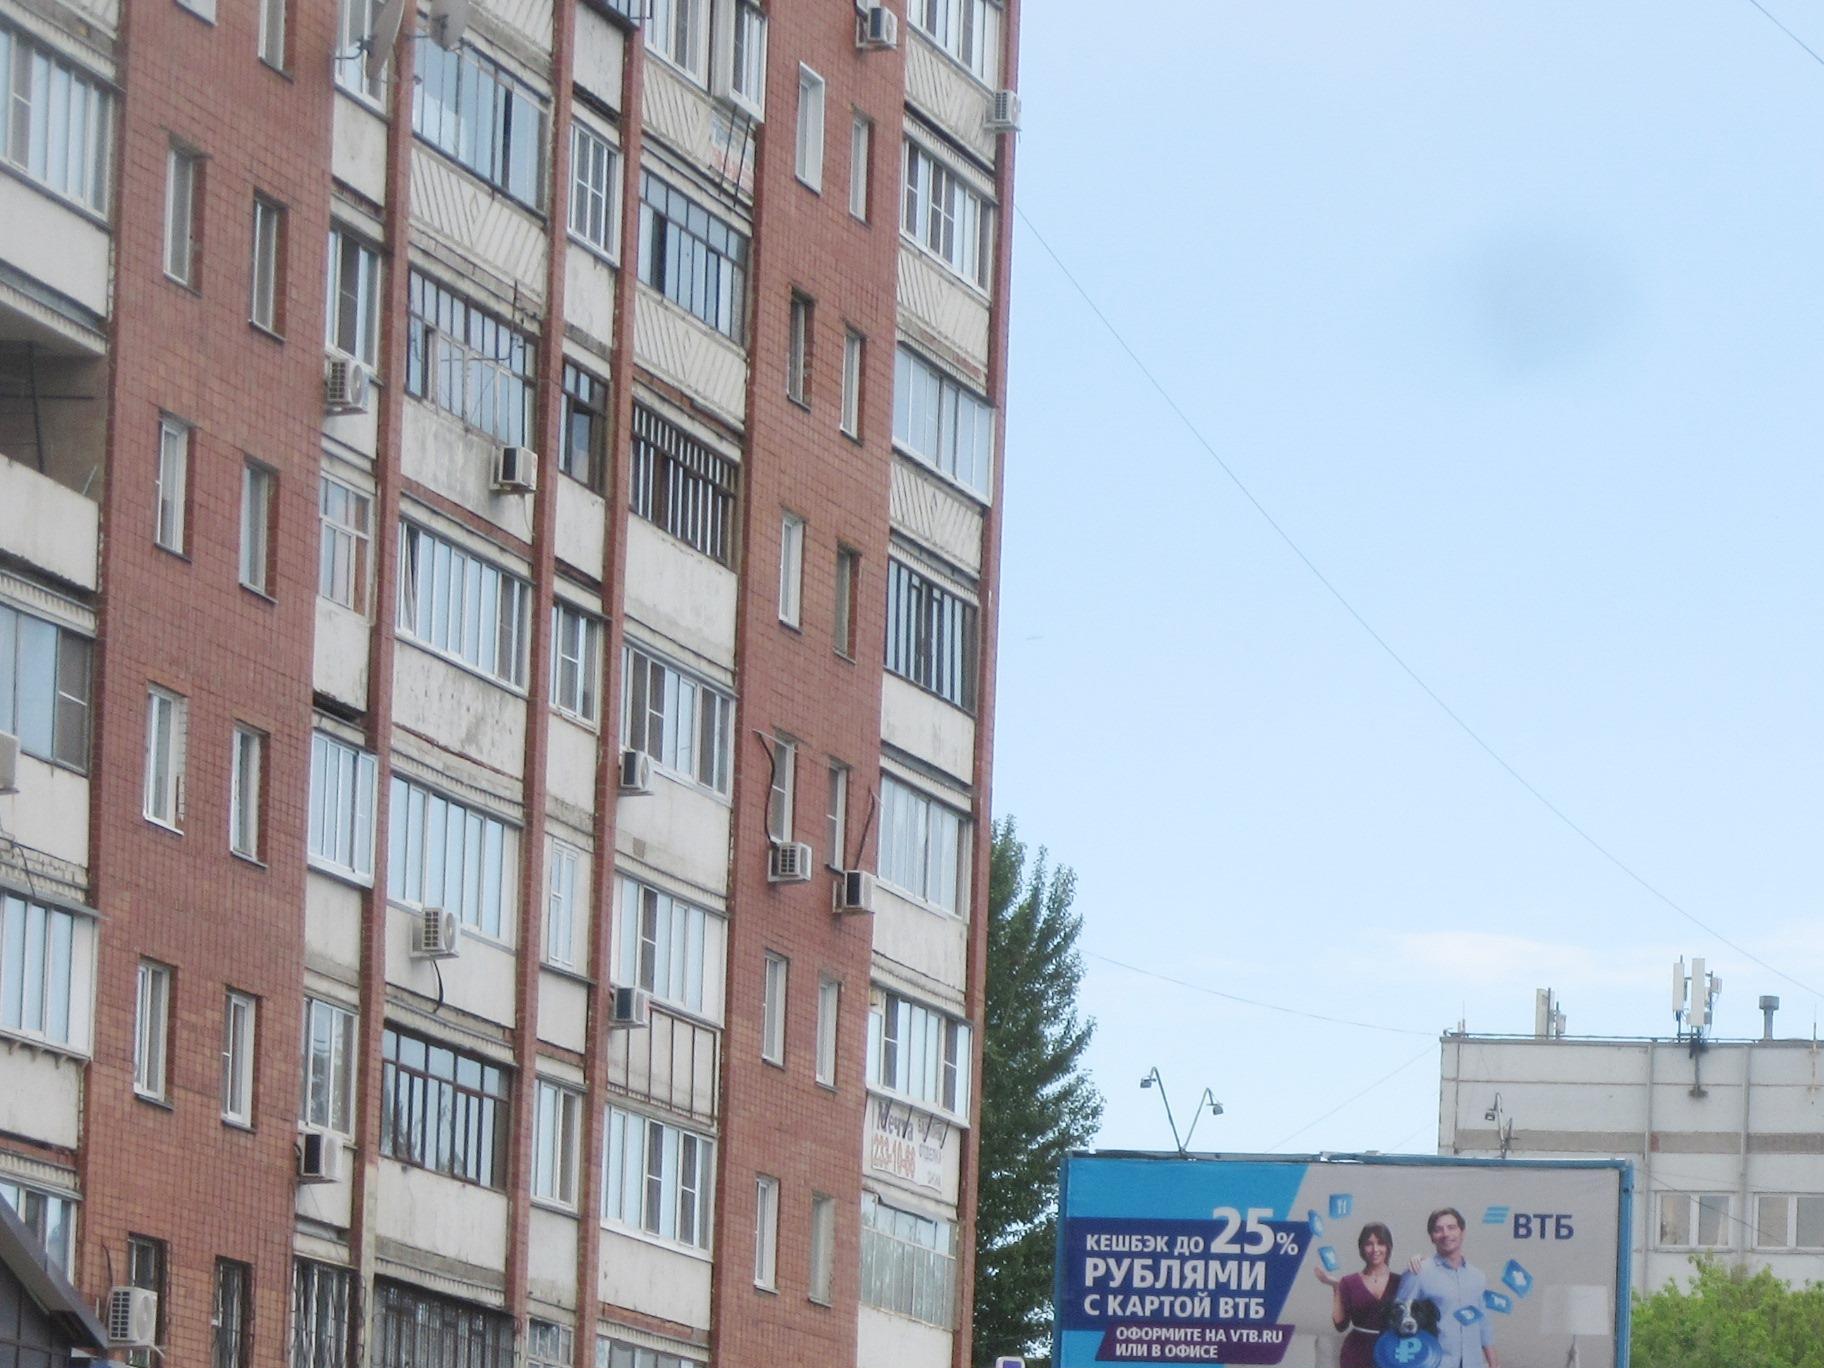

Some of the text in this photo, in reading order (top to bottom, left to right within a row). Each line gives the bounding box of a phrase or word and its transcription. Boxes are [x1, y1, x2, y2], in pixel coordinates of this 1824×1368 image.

[1086, 1206, 1299, 1256] КЕШБЭК ДО 25%
[1513, 1212, 1575, 1240] ВТБ
[1084, 1256, 1267, 1291] РУБЛЯМИ
[1083, 1291, 1266, 1319] С КАРТОЙ ВТБ
[1116, 1326, 1284, 1344] ОФОРМИТЕ НА VTB.RU
[1115, 1343, 1219, 1359] ИЛИ В ОФИСЕ
